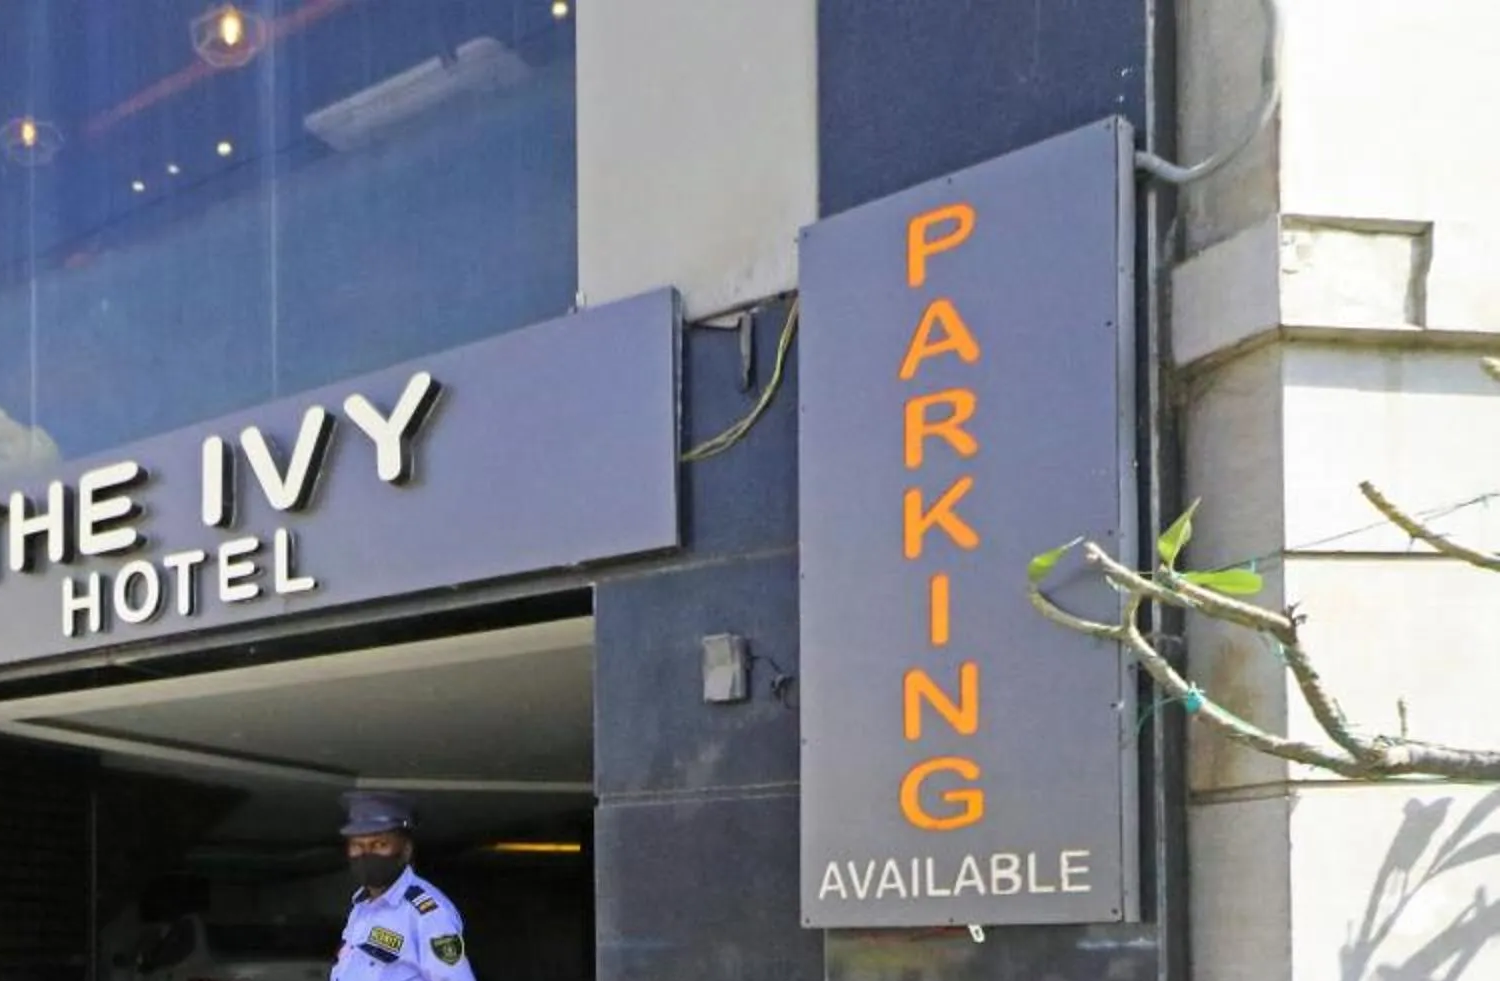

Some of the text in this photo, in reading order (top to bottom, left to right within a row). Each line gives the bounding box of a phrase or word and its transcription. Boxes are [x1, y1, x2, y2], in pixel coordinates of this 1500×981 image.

[202, 370, 434, 528] IVY
[62, 527, 316, 637] HOTEL
[900, 203, 985, 831] PARKING
[818, 850, 1092, 900] AVAILABLE
